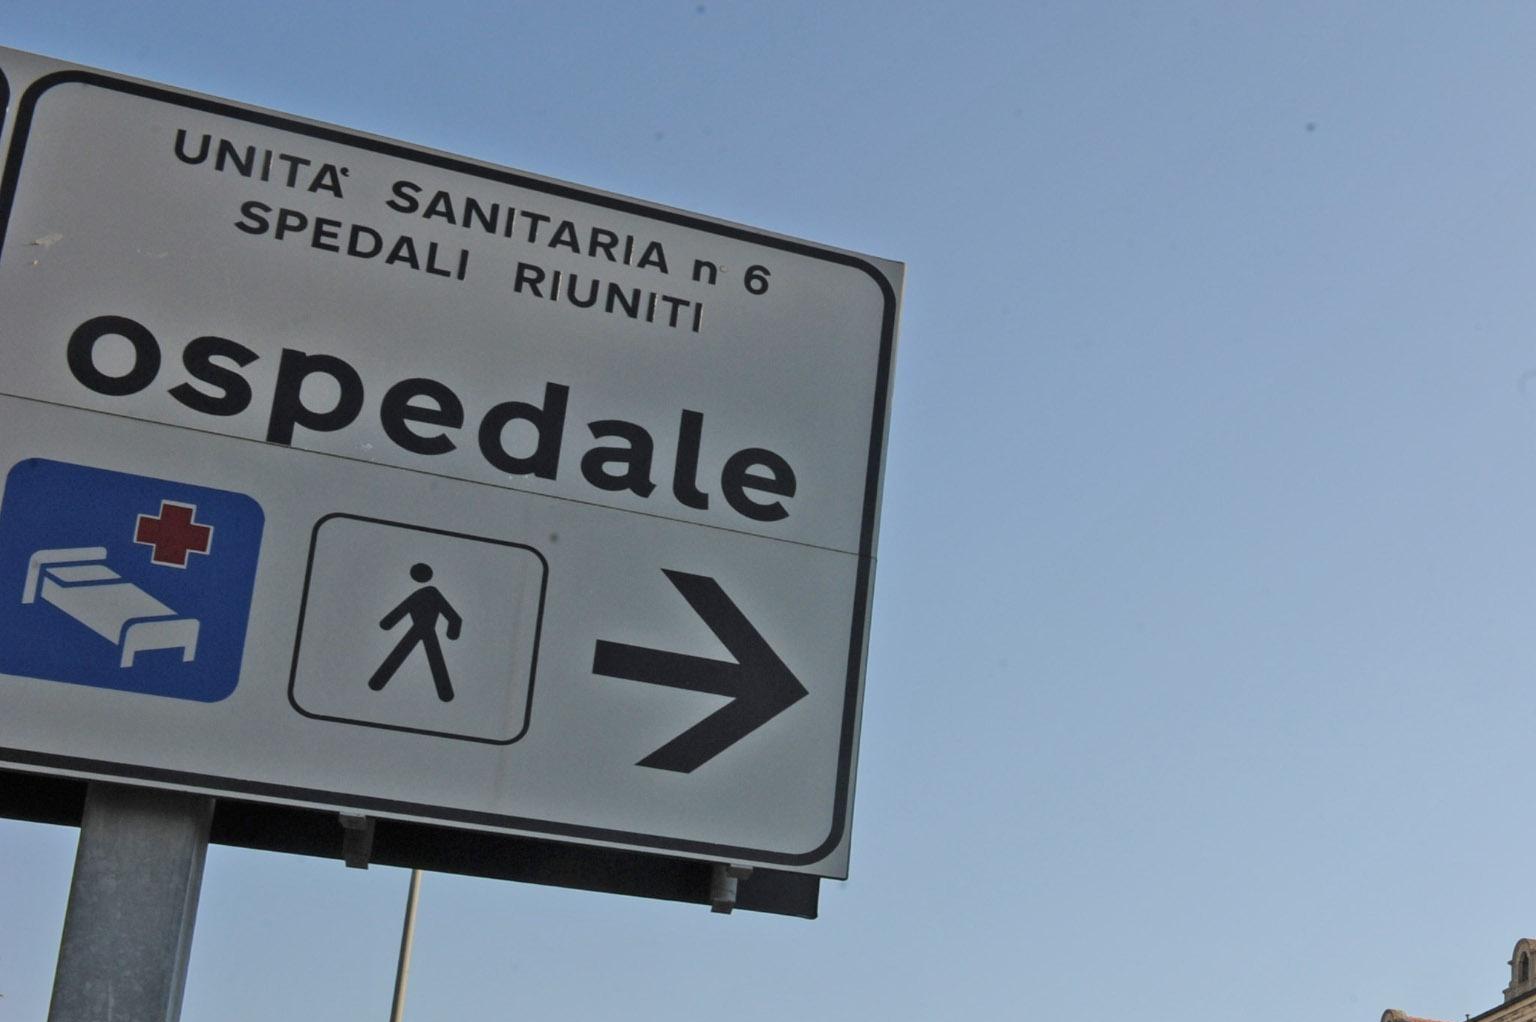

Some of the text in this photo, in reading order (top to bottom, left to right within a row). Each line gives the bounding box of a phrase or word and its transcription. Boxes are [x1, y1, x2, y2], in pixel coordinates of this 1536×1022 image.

[234, 200, 704, 333] SPEDALI RIUNITI
[385, 180, 670, 275] SANITARIA
[743, 264, 771, 295] 6
[66, 315, 797, 522] ospedale
